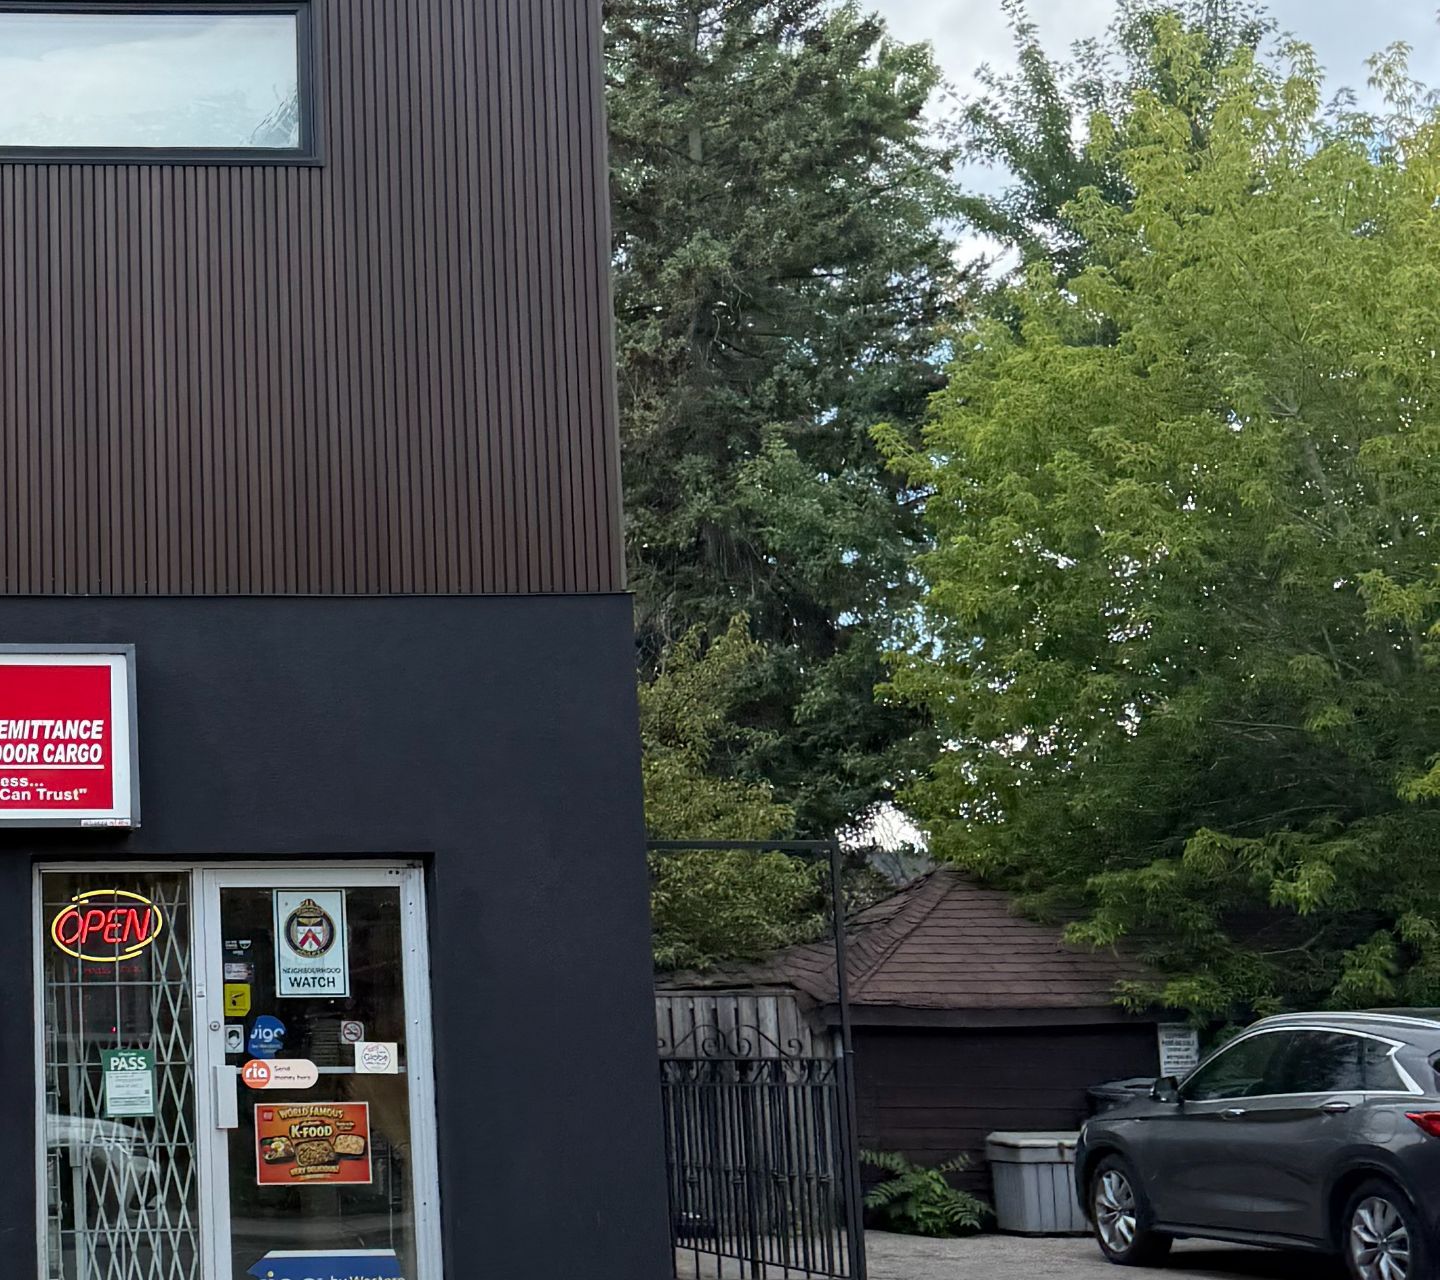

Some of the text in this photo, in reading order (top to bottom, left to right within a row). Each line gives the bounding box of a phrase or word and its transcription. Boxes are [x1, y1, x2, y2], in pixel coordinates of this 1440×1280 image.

[42, 743, 102, 763] CARGO
[35, 787, 88, 801] Trust"
[58, 908, 151, 944] OPEN
[289, 977, 335, 988] WATCH
[111, 1057, 146, 1070] PASS
[245, 1063, 268, 1079] ria
[278, 1107, 344, 1120] WORLD FAMOUS
[291, 1125, 333, 1138] K-FOOD
